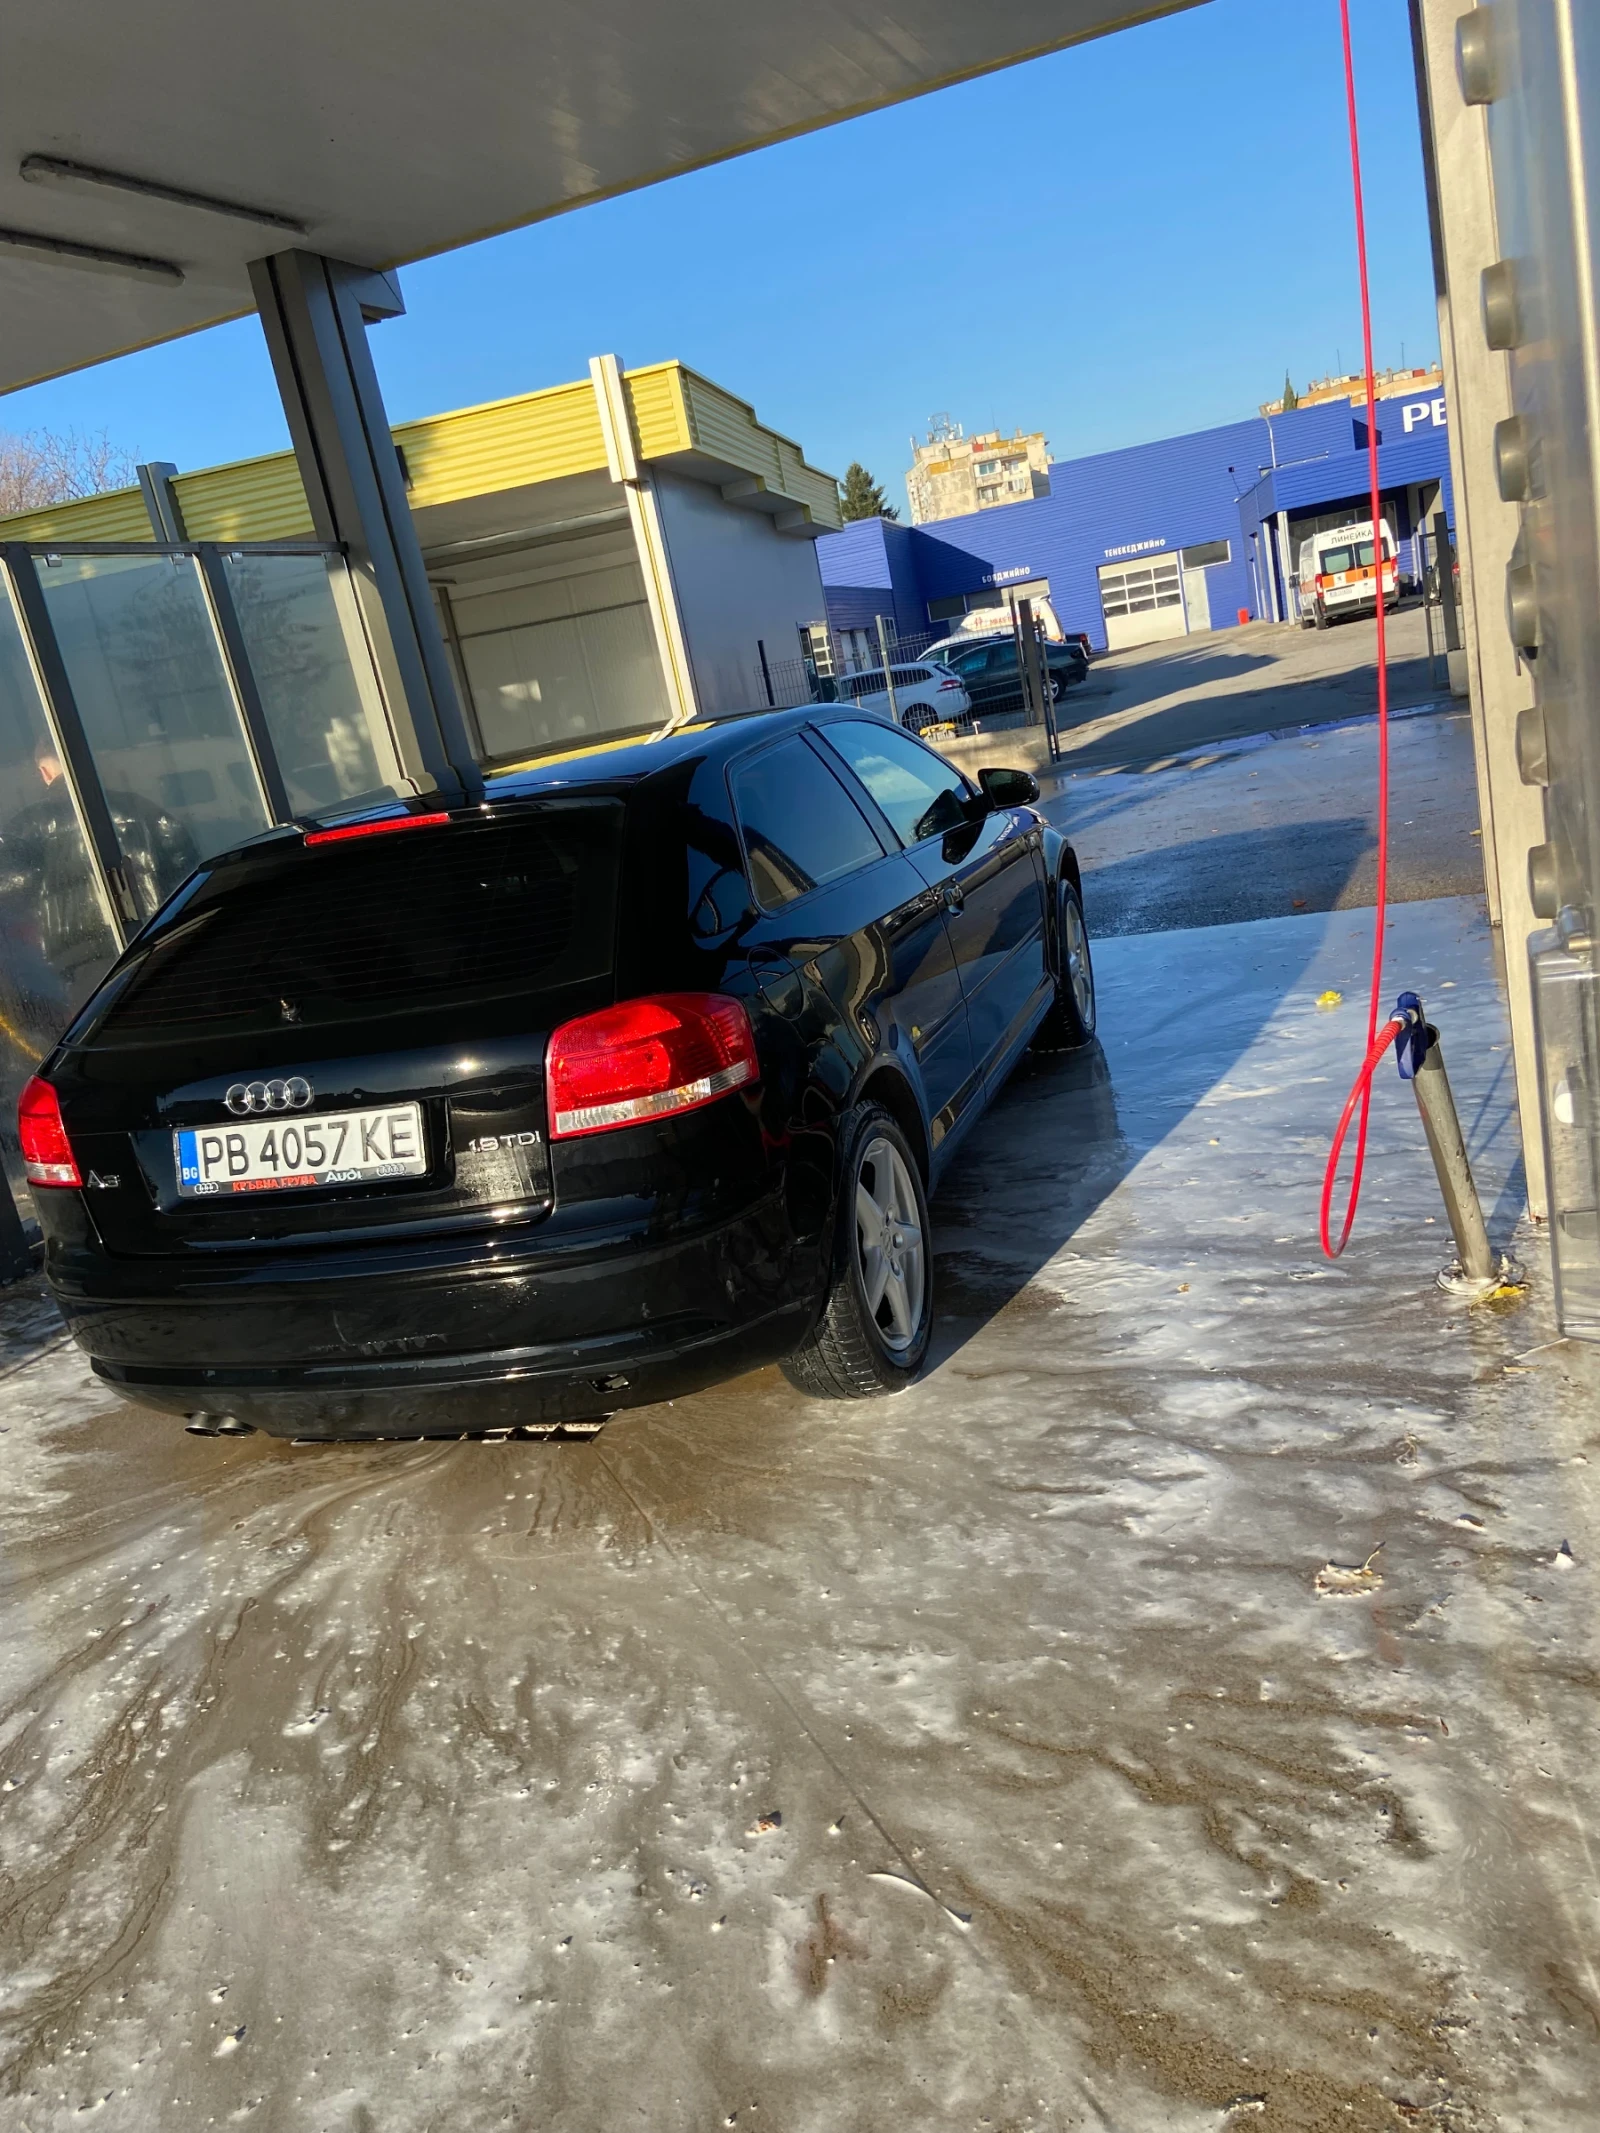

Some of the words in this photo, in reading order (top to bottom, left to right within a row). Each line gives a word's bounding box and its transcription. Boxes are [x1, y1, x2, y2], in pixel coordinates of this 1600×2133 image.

[1331, 528, 1374, 545] ЛИНЕЙКА
[1104, 538, 1166, 558] ТЕНЕКЕДЖИЙНО
[981, 566, 1031, 584] БОЯДЖИЙНО
[201, 1133, 249, 1179] PB
[259, 1121, 350, 1172] 4057
[360, 1113, 417, 1163] KE
[499, 1130, 541, 1148] TDI
[87, 1169, 119, 1188] A3
[182, 1166, 199, 1181] BG
[325, 1168, 362, 1183] Audi
